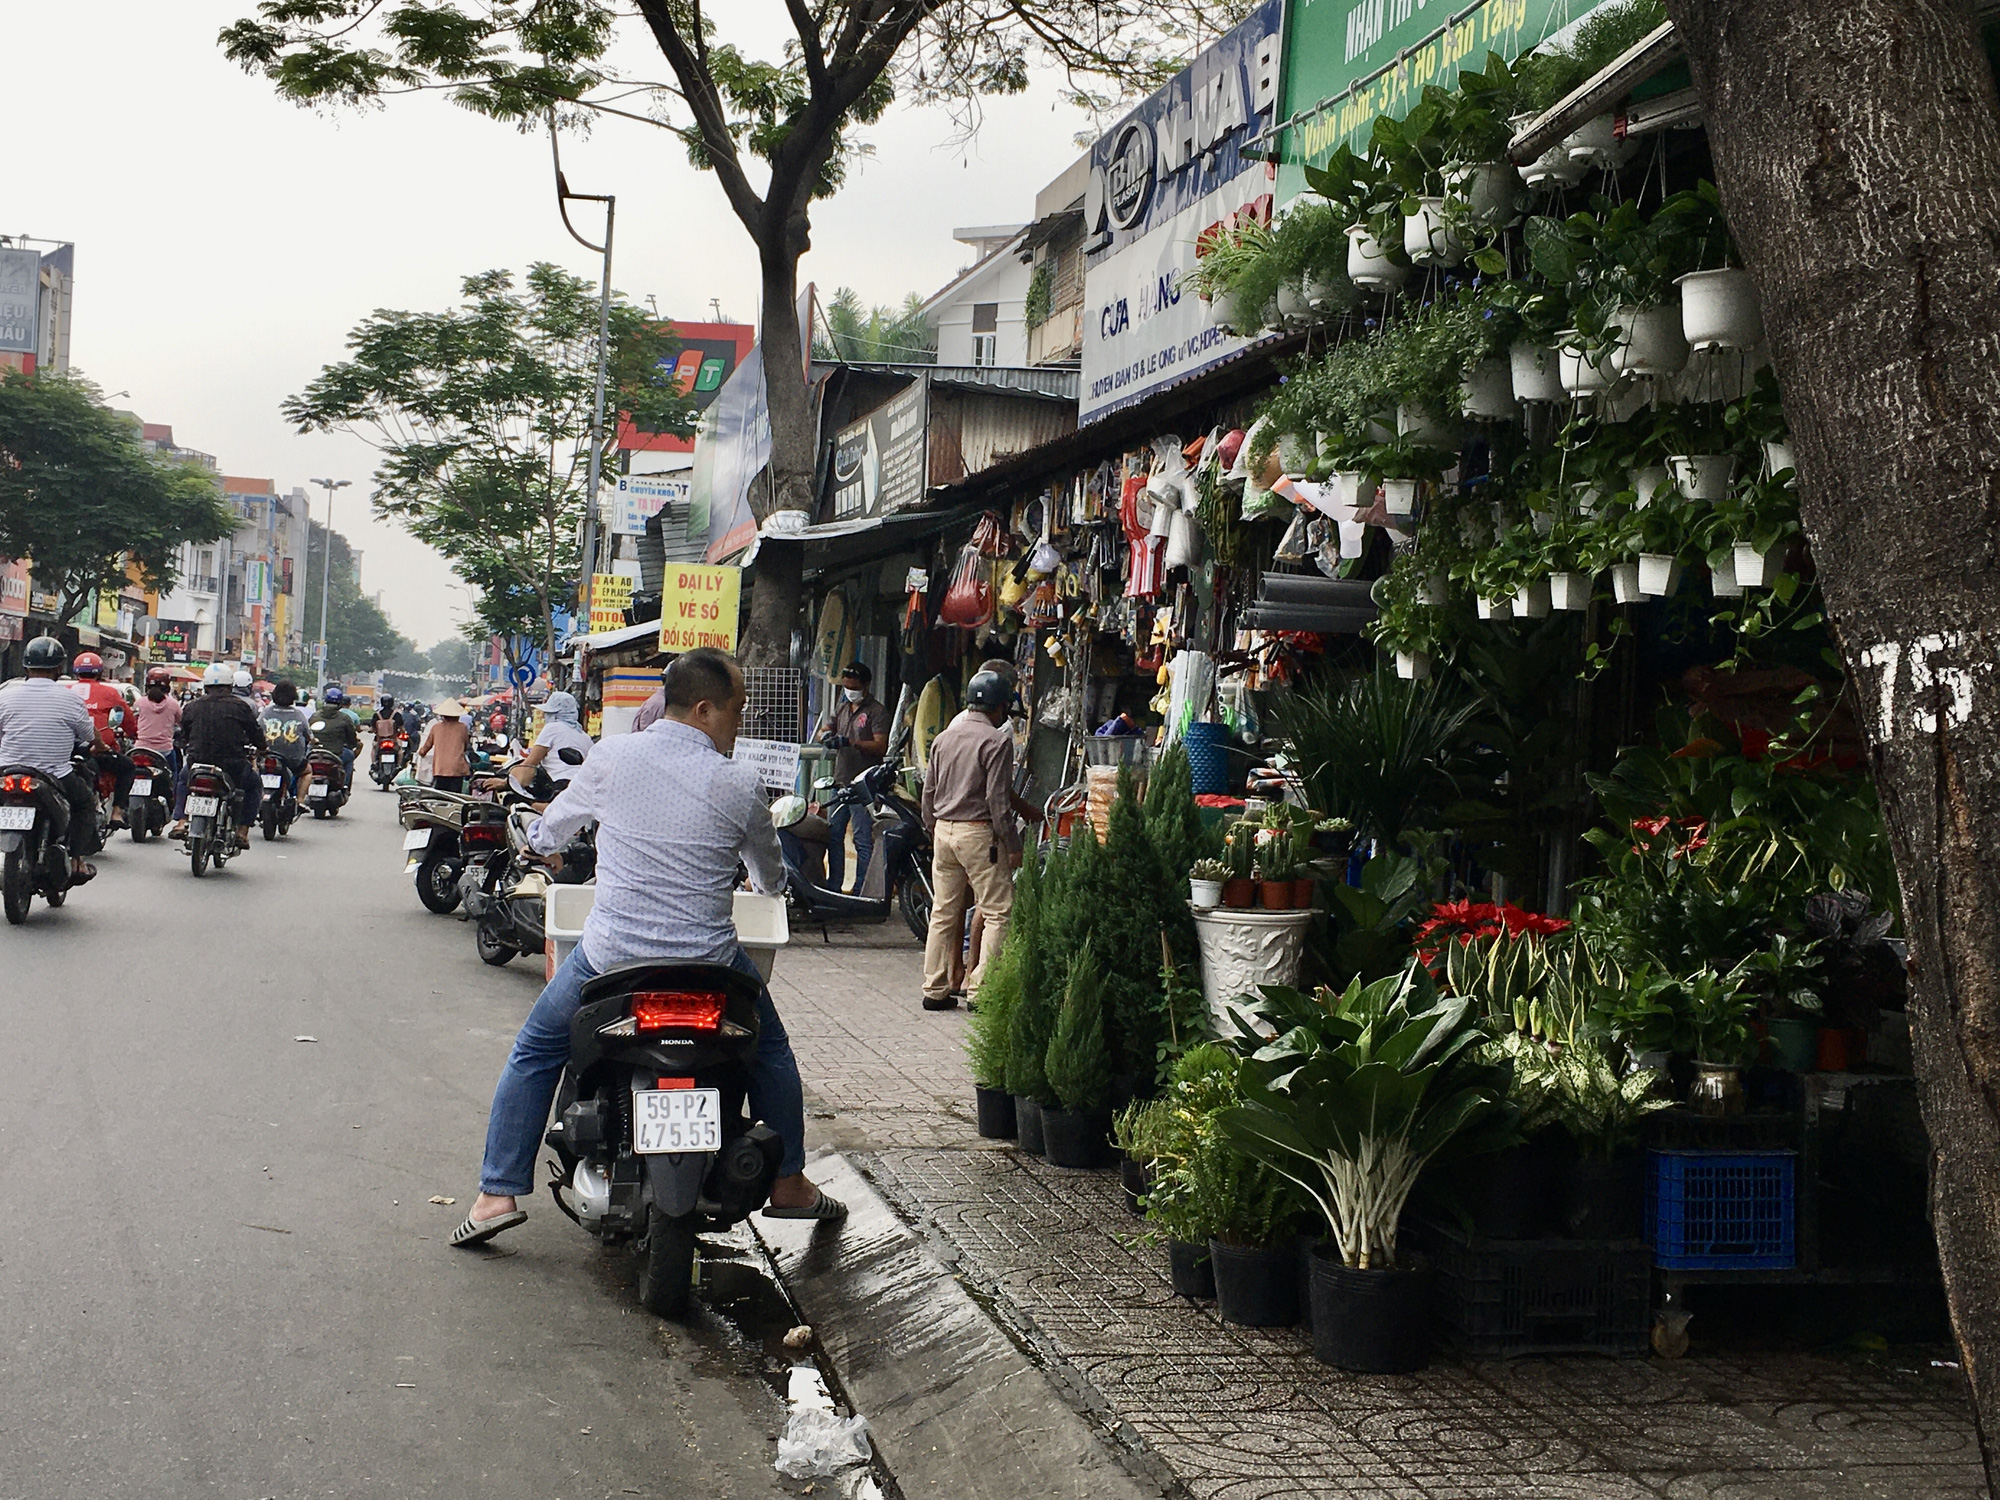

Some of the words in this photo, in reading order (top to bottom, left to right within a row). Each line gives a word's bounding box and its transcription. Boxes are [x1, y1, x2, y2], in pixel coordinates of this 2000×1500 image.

[603, 577, 614, 586] A4
[678, 573, 702, 594] ĐẠI
[706, 571, 723, 592] LÝ
[679, 598, 697, 618] VÉ
[700, 598, 719, 621] SỐ
[663, 622, 680, 646] ĐỔI
[682, 625, 696, 647] SỐ
[698, 628, 729, 650] TRÚNG
[660, 1038, 694, 1046] HONDA
[647, 1093, 708, 1120] 59-P2
[640, 1121, 716, 1149] 475.55
